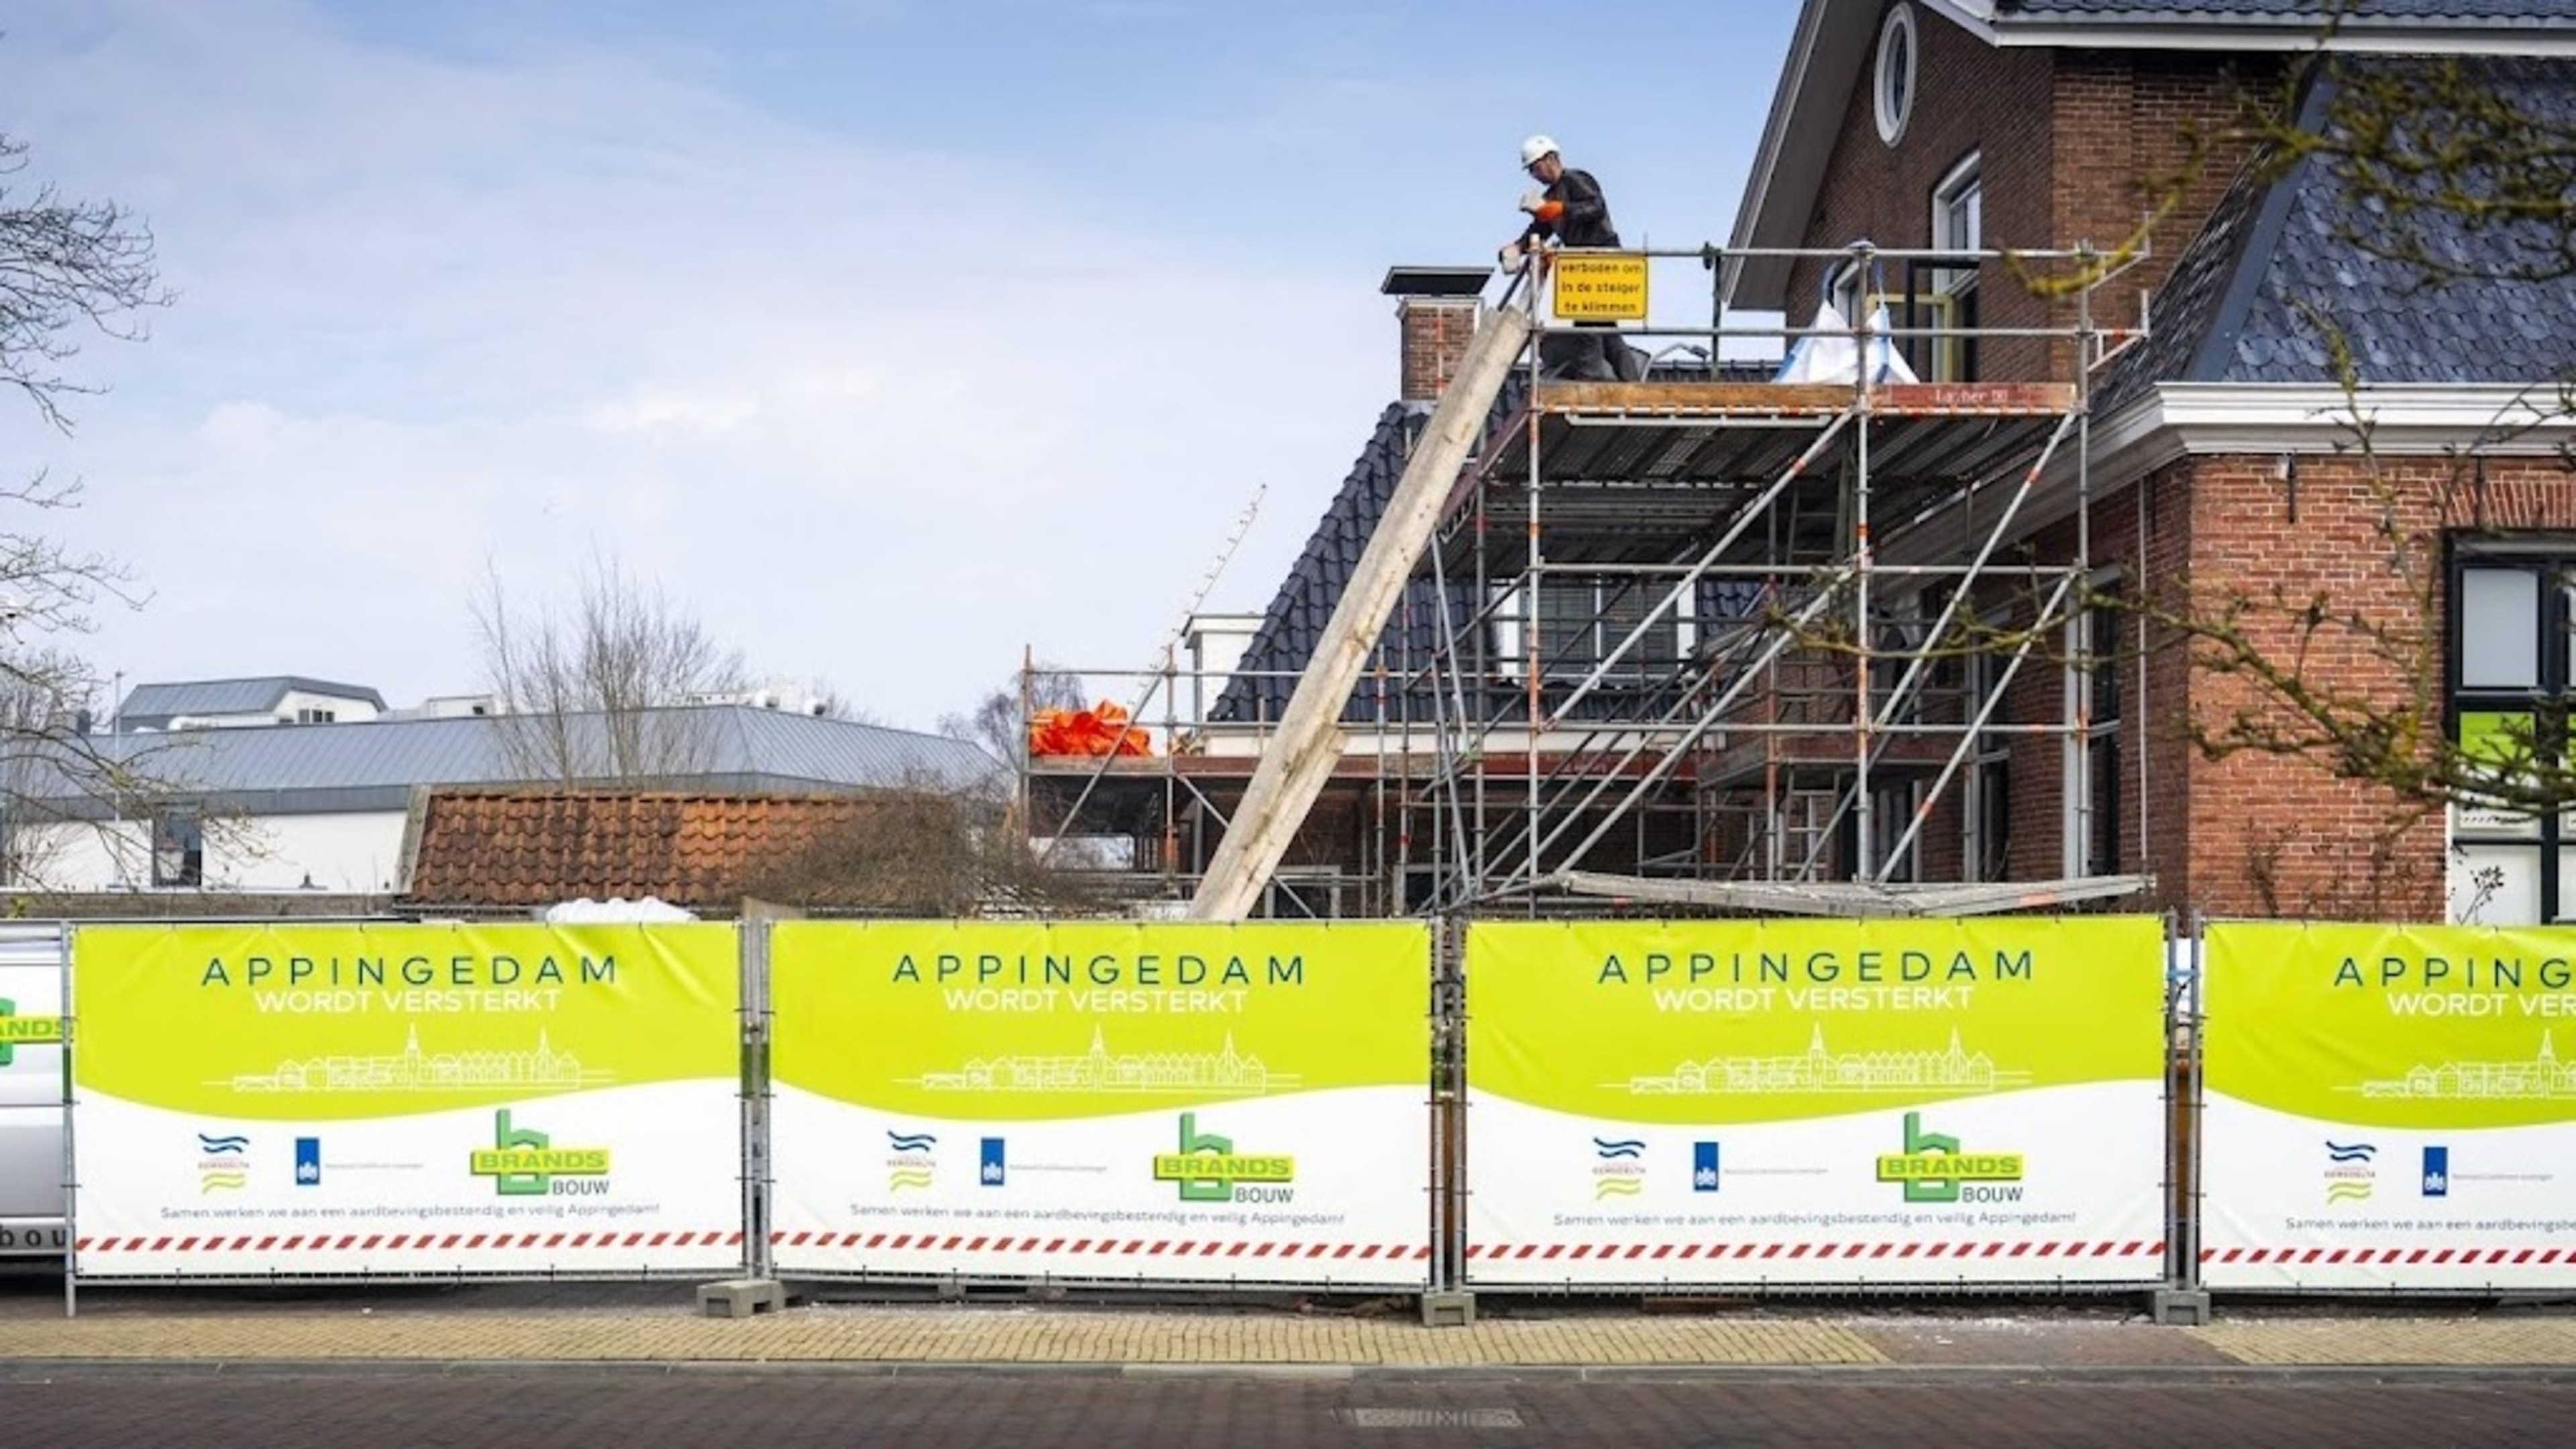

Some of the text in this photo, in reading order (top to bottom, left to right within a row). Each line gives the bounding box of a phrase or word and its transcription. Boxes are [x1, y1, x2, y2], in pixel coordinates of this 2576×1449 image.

[1577, 281, 1591, 293] de
[1597, 281, 1640, 295] steiger
[1564, 301, 1635, 313] te klimmen
[203, 955, 614, 985] APPINGEDAM
[892, 955, 1302, 985] APPINGEDAM
[1598, 951, 2031, 983] APPINGEDAM
[2334, 957, 2571, 989] APPING
[255, 987, 561, 1014] WORDT VERSTERKT
[945, 987, 1248, 1013] WORDT VERSTERKT
[1653, 985, 1973, 1012] WORDT VERSTERKT
[2387, 994, 2576, 1016] WORDT VER
[479, 1152, 605, 1168] BRANDS
[1163, 1158, 1289, 1174] BRANDS
[1886, 1157, 2019, 1174] BRANDS
[553, 1179, 610, 1195] BOUW
[1234, 1187, 1294, 1203] BOUW
[1962, 1187, 2023, 1203] BOUW
[268, 1209, 287, 1218] we
[291, 1209, 317, 1218] aan
[321, 1208, 345, 1218] een
[508, 1207, 524, 1216] en
[953, 1208, 971, 1218] we
[976, 1209, 1001, 1218] aan
[1004, 1210, 1029, 1219] een
[1190, 1212, 1208, 1222] en
[1664, 1215, 1684, 1225] we
[1688, 1215, 1714, 1225] aan
[1719, 1214, 1745, 1224] een
[1915, 1214, 1933, 1224] en
[2393, 1220, 2413, 1230] we
[2417, 1220, 2440, 1230] aan
[2447, 1220, 2471, 1230] een
